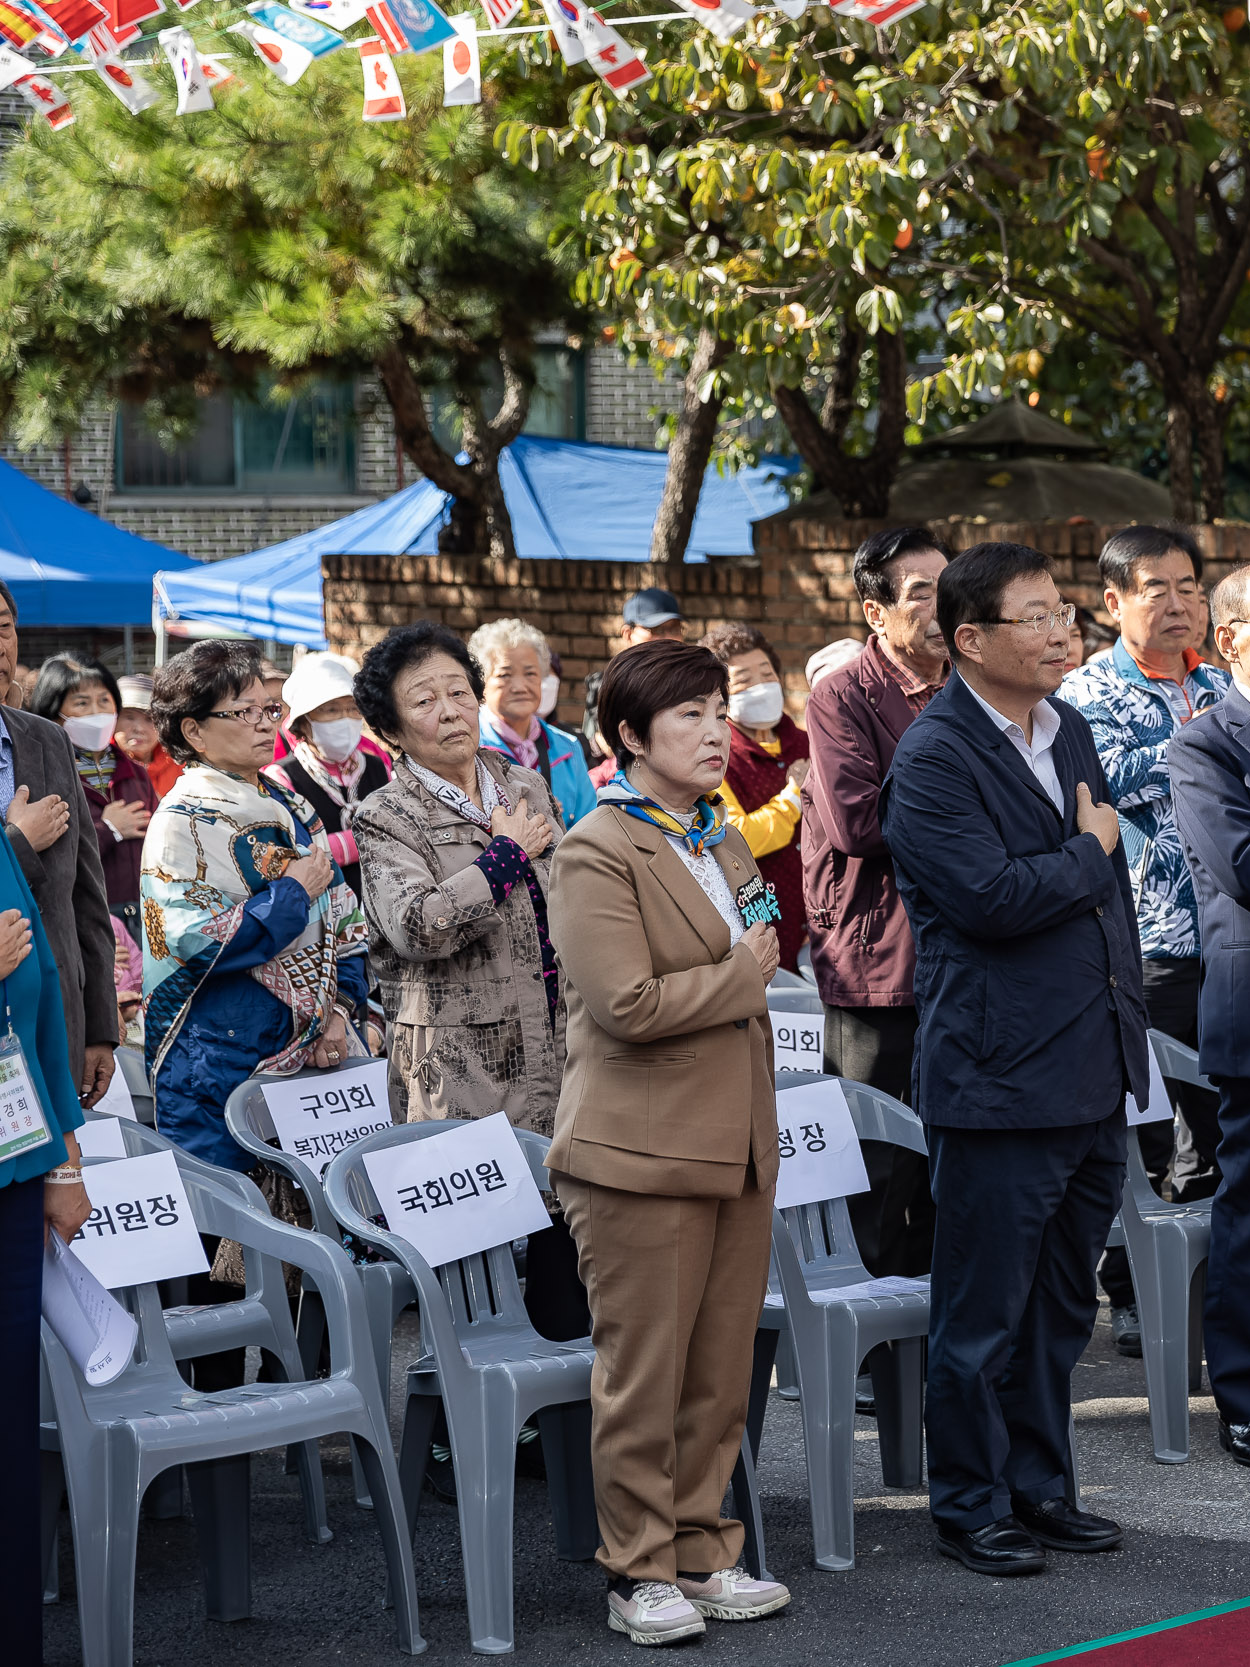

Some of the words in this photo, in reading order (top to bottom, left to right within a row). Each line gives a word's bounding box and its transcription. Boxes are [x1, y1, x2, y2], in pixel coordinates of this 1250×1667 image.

[739, 876, 765, 903] 국회의원
[299, 1083, 376, 1119] 구의회
[397, 1159, 507, 1214] 국회의원
[74, 1193, 180, 1241] 위원장
